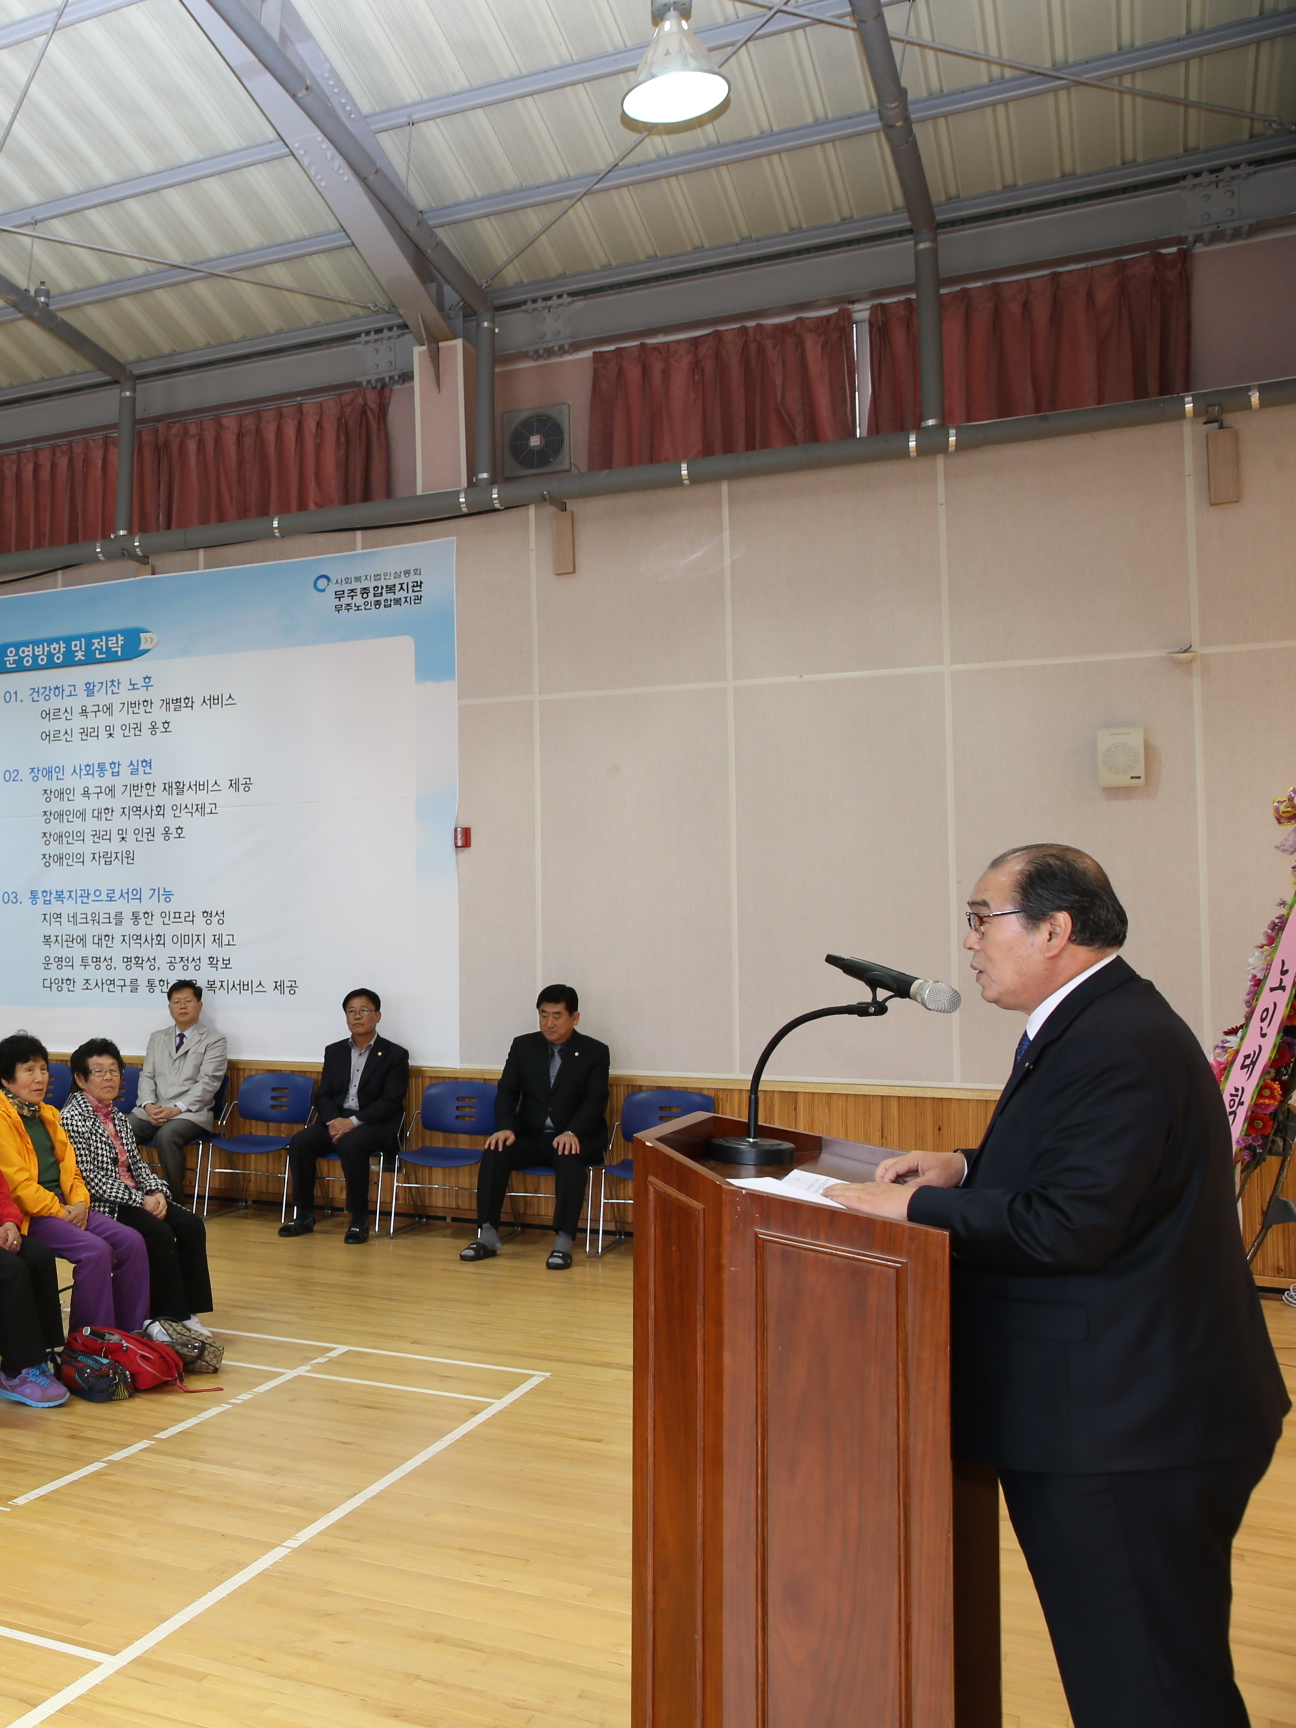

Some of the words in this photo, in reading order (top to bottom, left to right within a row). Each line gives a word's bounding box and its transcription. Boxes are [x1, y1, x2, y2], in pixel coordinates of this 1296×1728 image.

[334, 580, 423, 602] 무주종합복지관
[334, 595, 422, 613] 무주노인종합복지관
[4, 642, 66, 668] 운영방향
[71, 639, 86, 661] 및
[91, 634, 124, 657] 전략
[4, 691, 23, 703] 01.
[29, 685, 78, 702] 건강하고
[84, 679, 121, 696] 활기찬
[127, 675, 154, 692] 노후
[40, 707, 73, 721] 어르신
[78, 703, 113, 719] 욕구에
[119, 699, 153, 716] 기반한
[159, 696, 194, 711] 개별화
[200, 693, 237, 708] 서비스
[40, 729, 73, 744] 어르신
[78, 726, 99, 741] 권리
[105, 724, 115, 739] 및
[120, 723, 142, 738] 인권
[148, 721, 172, 736] 옹호
[4, 769, 23, 782] 02.
[29, 765, 65, 782] 장애인
[71, 761, 121, 779] 사회통합
[127, 759, 152, 775] 실현
[42, 788, 75, 803] 장애인
[80, 784, 116, 800] 욕구에
[121, 782, 156, 798] 기반한
[161, 779, 222, 796] 재활서비스
[228, 777, 253, 794] 제공
[42, 808, 87, 824] 장애인에
[92, 806, 114, 822] 대한
[120, 804, 165, 821] 지역사회
[171, 803, 219, 819] 인식제고
[41, 830, 85, 846] 장애인의
[90, 828, 112, 844] 권리
[117, 827, 128, 842] 및
[133, 826, 156, 842] 인권
[161, 825, 186, 840] 옹호
[41, 852, 85, 867] 장애인의
[90, 850, 135, 866] 자립지원
[2, 891, 22, 905] 03.
[28, 887, 142, 905] 통합복지관으로서의
[148, 887, 174, 903] 기능
[42, 911, 62, 926] 지역
[67, 912, 125, 926] 네크워크를
[130, 911, 154, 926] 통한
[160, 910, 195, 925] 인프라
[201, 910, 226, 925] 형성
[42, 934, 87, 948] 복지관에
[92, 934, 114, 948] 대한
[120, 934, 166, 949] 지역사회
[171, 933, 206, 948] 이미지
[211, 933, 236, 948] 제고
[42, 956, 74, 970] 운영의
[79, 956, 117, 972] 투명성,
[122, 956, 160, 972] 명확성,
[166, 956, 202, 972] 공정성
[207, 956, 233, 972] 확보
[42, 978, 76, 993] 다양한
[82, 978, 140, 994] 조사연구를
[145, 978, 168, 995] 통한
[205, 980, 267, 995] 복지서비스
[273, 980, 299, 995] 제공
